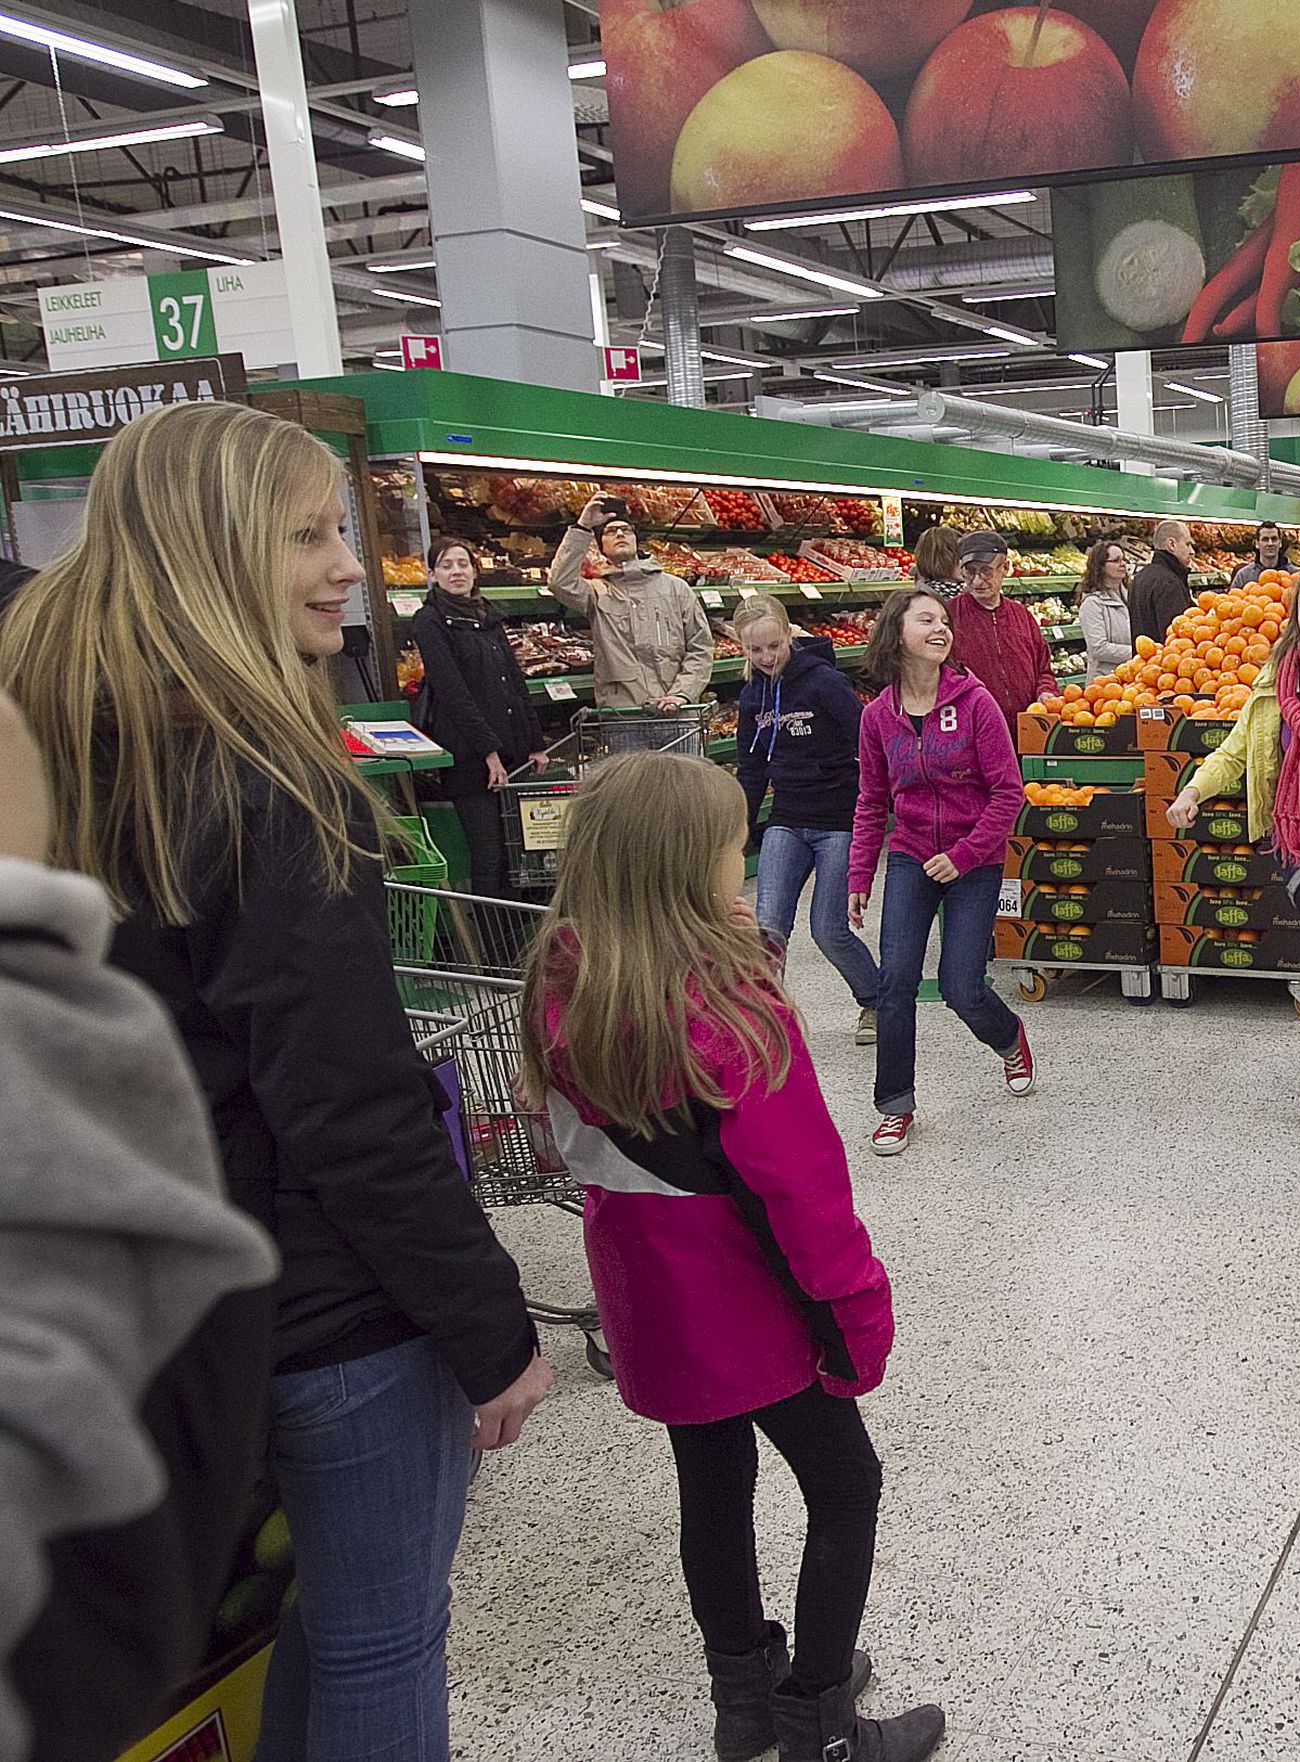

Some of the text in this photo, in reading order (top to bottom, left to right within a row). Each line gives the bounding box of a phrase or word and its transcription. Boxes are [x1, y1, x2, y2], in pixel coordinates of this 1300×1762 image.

[216, 276, 244, 293] LIHA
[46, 291, 103, 312] LEIKKELEET
[160, 295, 204, 351] 37
[49, 325, 106, 345] JAUHELIHA
[0, 380, 214, 437] ÄHIRUOKAA
[940, 705, 958, 732] 8
[998, 899, 1017, 912] 064
